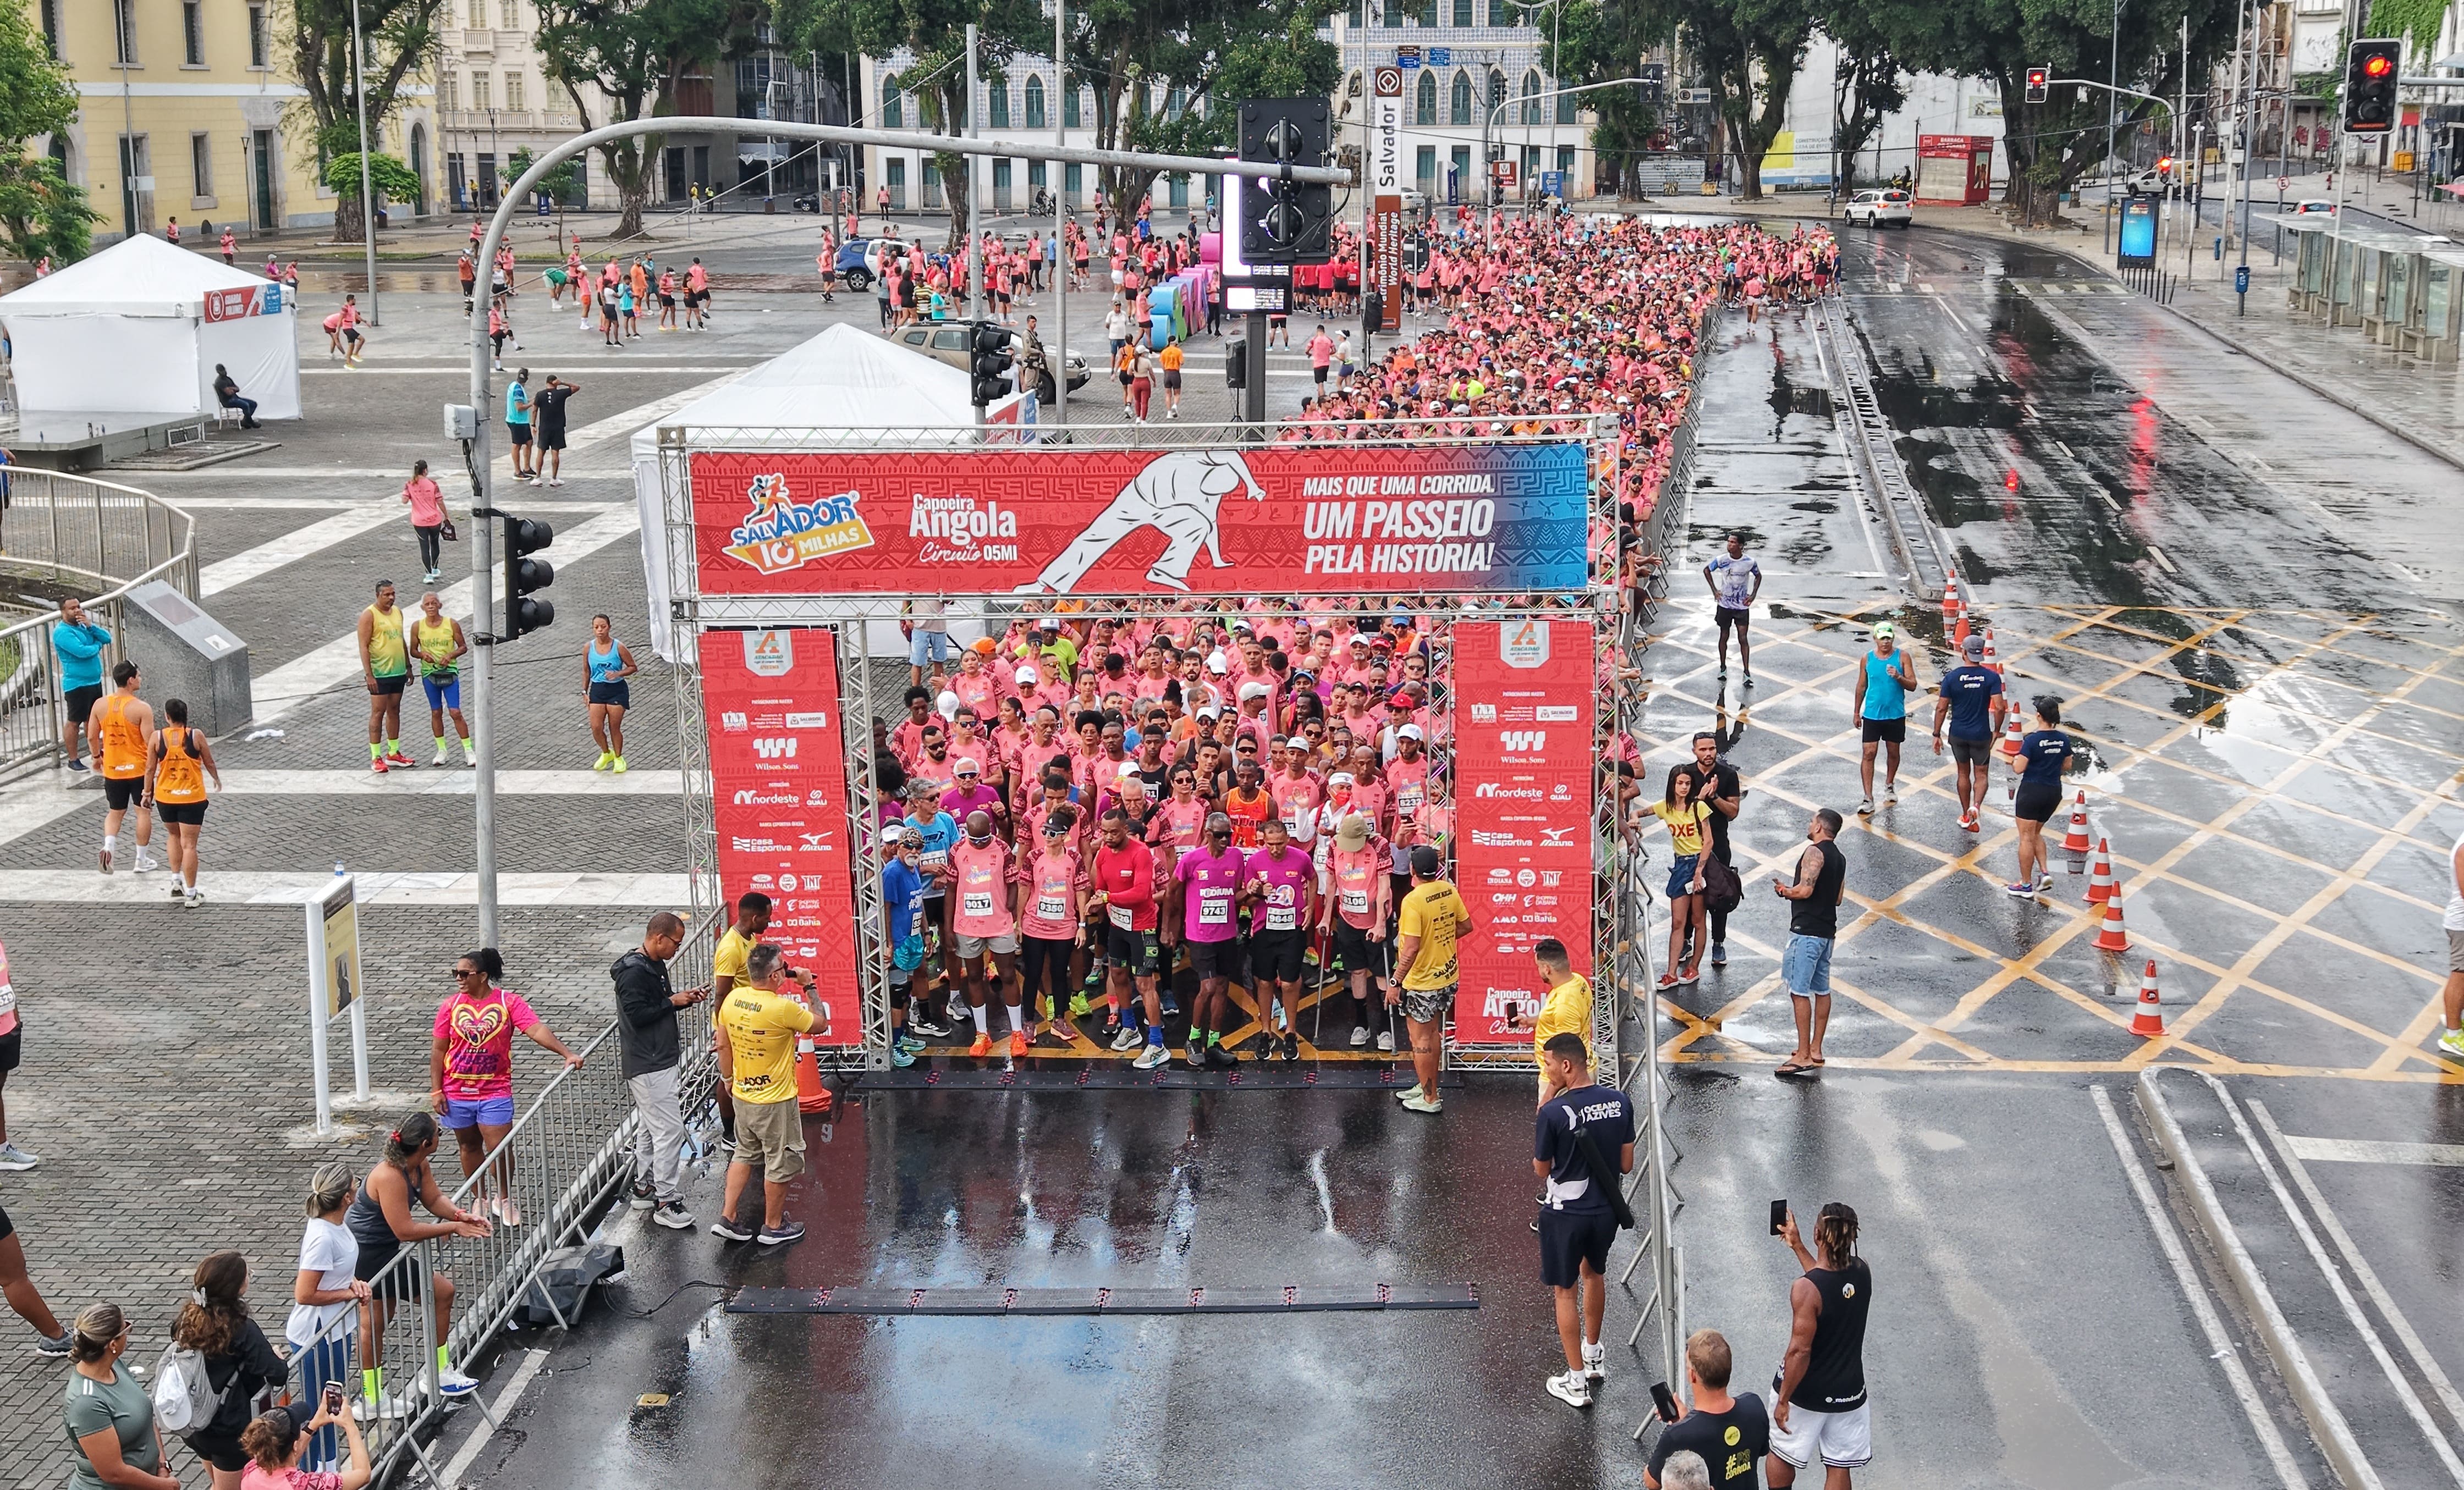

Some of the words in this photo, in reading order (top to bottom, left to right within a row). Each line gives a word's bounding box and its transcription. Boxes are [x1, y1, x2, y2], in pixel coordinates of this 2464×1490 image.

[1379, 104, 1395, 188] Salvador
[2281, 179, 2286, 187] E
[1378, 211, 1388, 252] Mundial
[1388, 211, 1400, 251] Heritage
[1388, 255, 1400, 287] World
[1304, 477, 1342, 495] MAIS
[1346, 477, 1377, 495] QUE
[1380, 476, 1416, 495] UMA
[1420, 474, 1494, 494] CORRIDA.
[912, 493, 975, 512] Capoeira
[732, 495, 856, 547] SALVADOR
[909, 501, 1016, 545] Angola
[1304, 501, 1355, 538] UM
[1362, 499, 1494, 538] PASSEIO
[800, 529, 860, 555] MILHAS
[920, 543, 982, 562] Circuito
[984, 546, 1017, 561] 05MI
[1305, 544, 1366, 573] PELA
[1371, 536, 1493, 572] HISTÓRIA!
[753, 793, 799, 804] nordeste
[1495, 788, 1543, 797] nordeste
[802, 876, 820, 889] TNT
[1542, 872, 1560, 886] TNT
[966, 899, 988, 908] 9017
[1492, 893, 1517, 902] OHH
[1487, 987, 1531, 999] Capoeira
[734, 998, 762, 1012] LOCUÇÃO
[1585, 1101, 1621, 1114] OCEANO
[1586, 1109, 1621, 1122] AZIVES
[1726, 1463, 1751, 1480] CORRIDA
